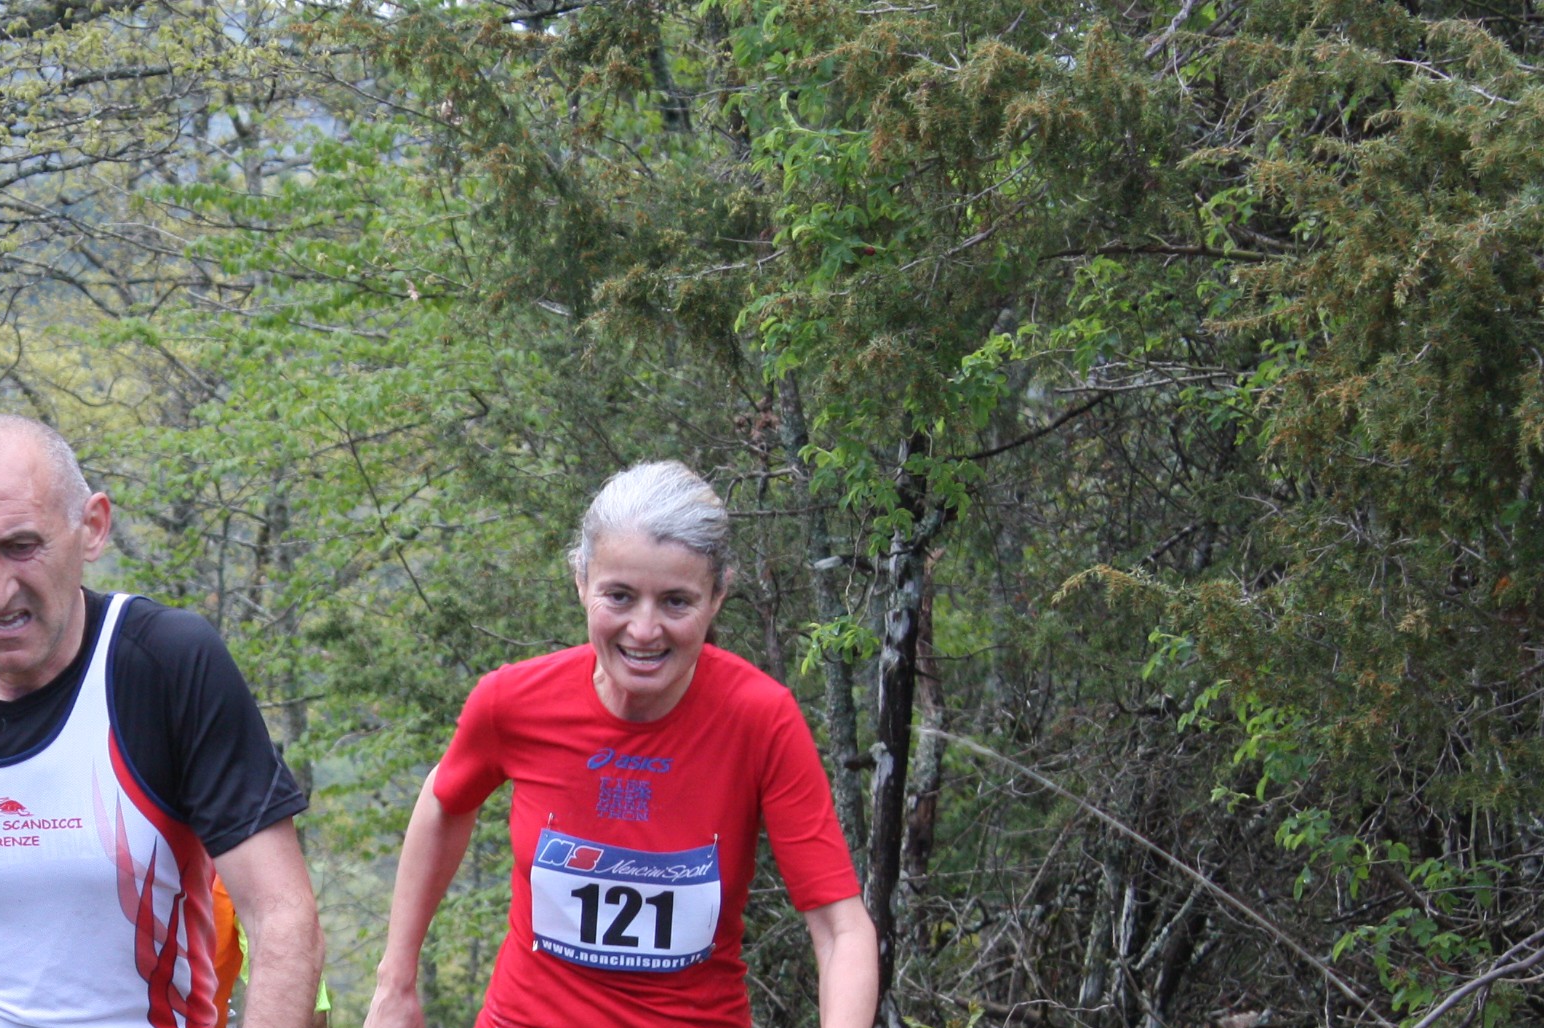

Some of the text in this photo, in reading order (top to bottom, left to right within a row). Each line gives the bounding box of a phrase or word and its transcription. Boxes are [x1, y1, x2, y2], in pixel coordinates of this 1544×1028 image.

[614, 754, 674, 773] asics
[2, 817, 83, 831] SCANDICCI
[571, 883, 674, 950] 121
